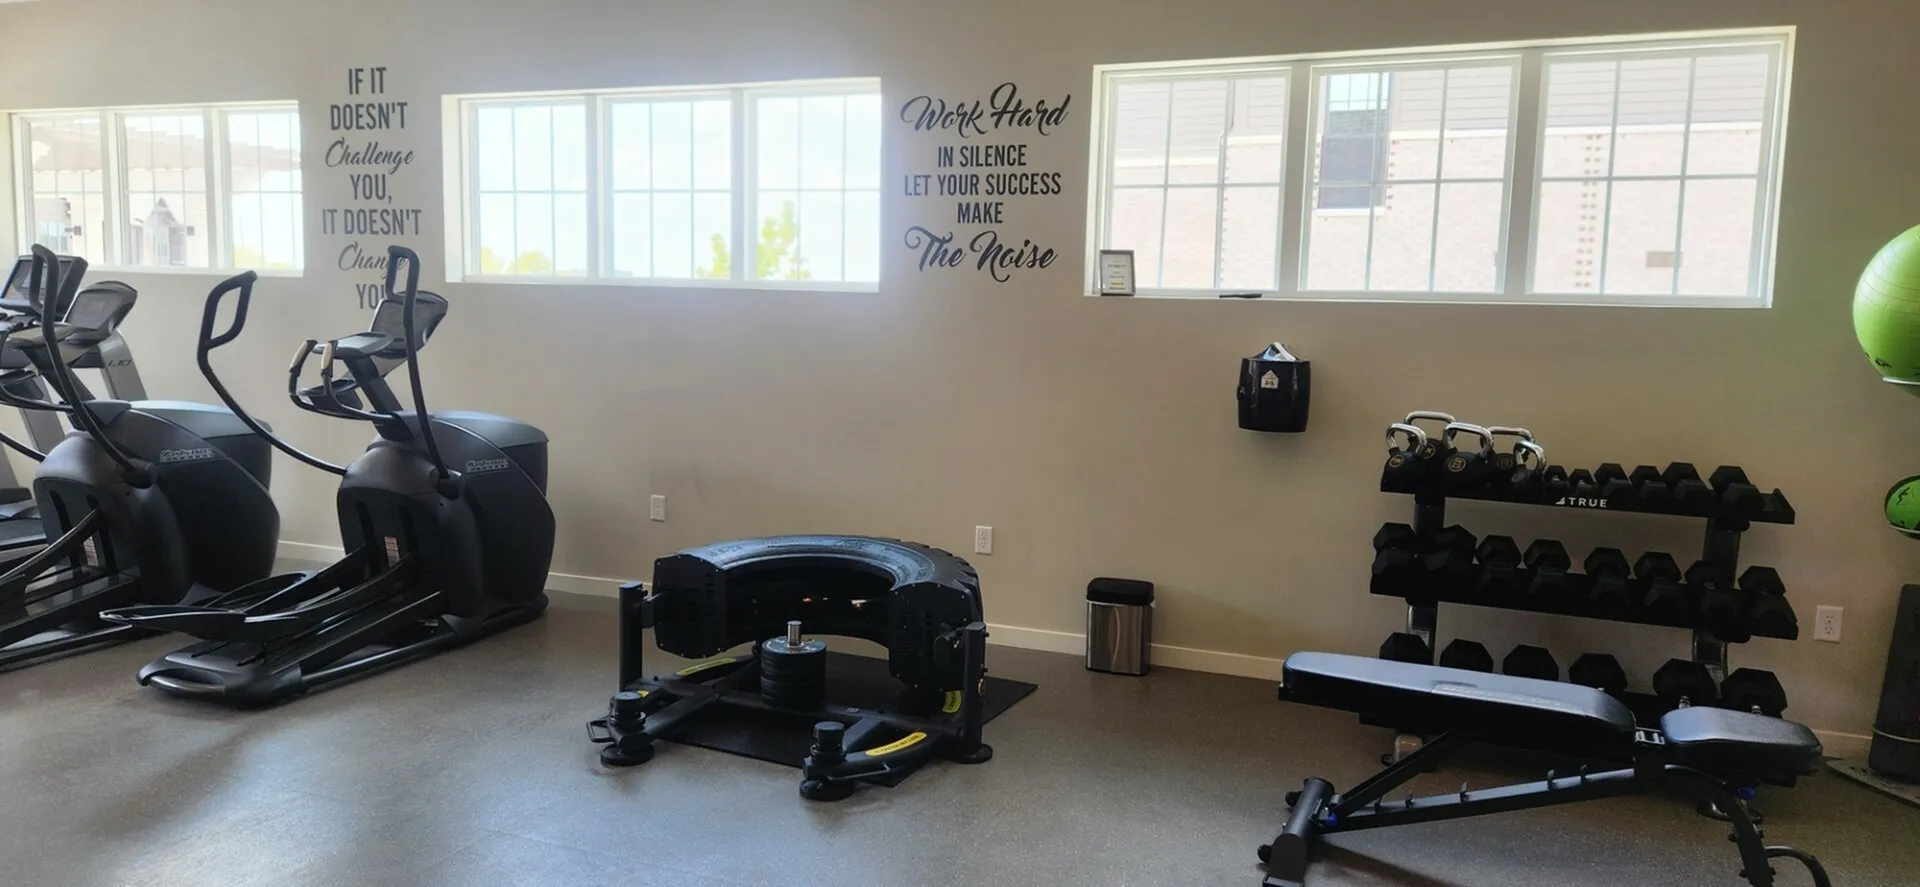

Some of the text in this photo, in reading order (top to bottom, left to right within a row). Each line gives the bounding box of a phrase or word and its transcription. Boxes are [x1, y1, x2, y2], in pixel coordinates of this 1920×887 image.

[348, 67, 387, 95] IF IT
[330, 102, 408, 131] DOESN'T
[900, 82, 1071, 139] Work Hard
[325, 137, 415, 175] Challenge
[938, 144, 1027, 168] IN SILENCE
[349, 174, 392, 204] YOU,
[905, 172, 1062, 197] LET YOUR SUCCESS
[322, 208, 422, 235] IT DOESN'T
[957, 202, 1004, 224] MAKE
[904, 226, 967, 272] The
[969, 230, 1058, 283] Noise
[1567, 496, 1608, 508] TRUE
